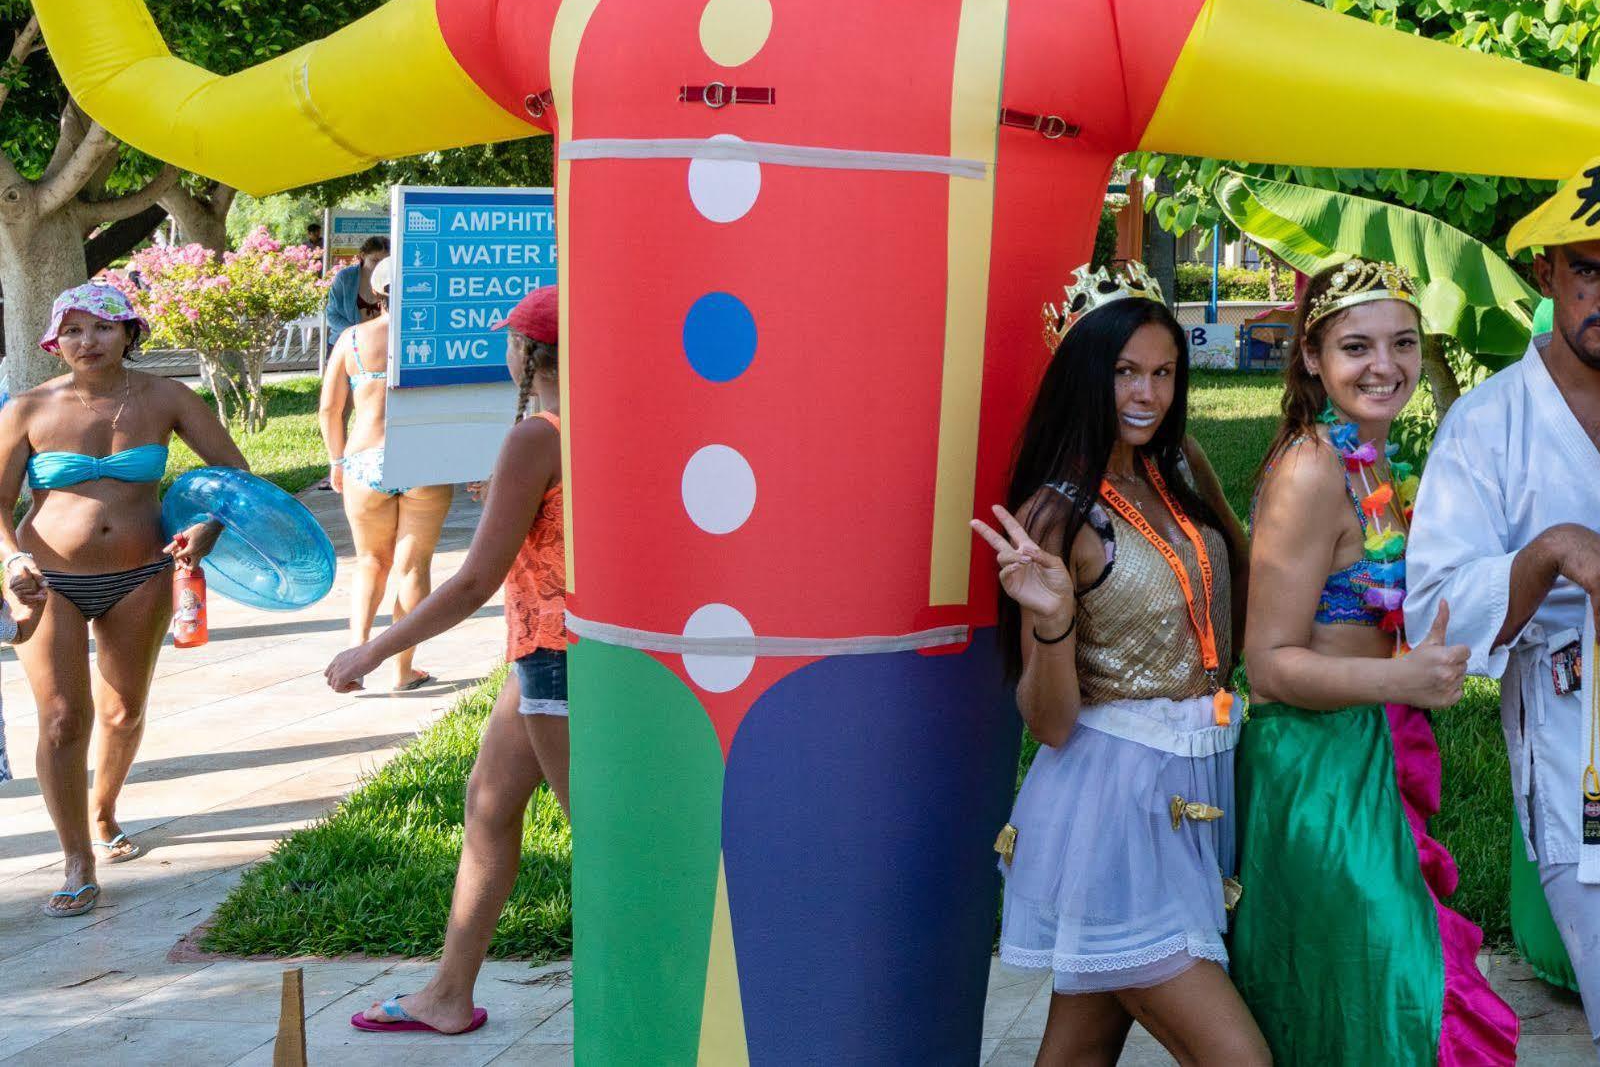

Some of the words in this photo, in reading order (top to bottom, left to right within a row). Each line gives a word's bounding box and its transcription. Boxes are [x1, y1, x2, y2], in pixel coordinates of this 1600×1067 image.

[448, 245, 541, 265] WATER
[449, 276, 541, 297] BEACH
[449, 308, 515, 329] SNA
[445, 339, 489, 360] WC
[1104, 488, 1177, 560] KROEGENTOCHT
